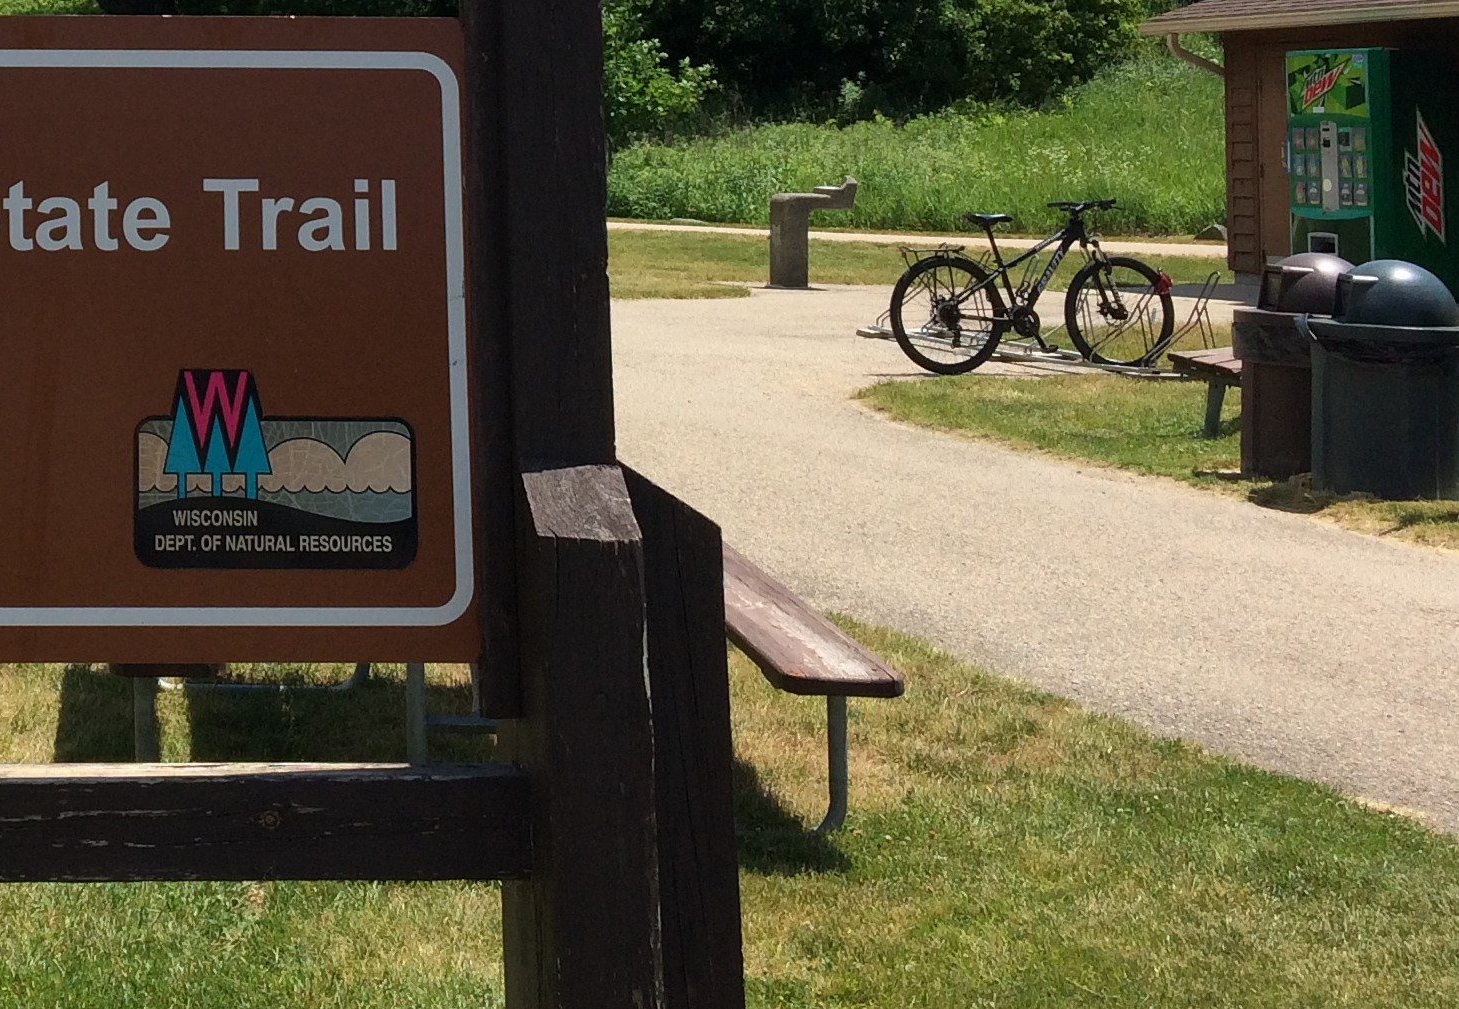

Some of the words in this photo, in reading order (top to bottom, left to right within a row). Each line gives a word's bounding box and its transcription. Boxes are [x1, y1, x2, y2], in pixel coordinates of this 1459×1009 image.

[203, 178, 397, 252] Trail
[172, 509, 258, 527] WISCONSIN
[154, 534, 197, 552] DEPT.
[200, 534, 222, 552] OF
[225, 534, 296, 553] NATURAL
[299, 535, 393, 553] RESOURCES
